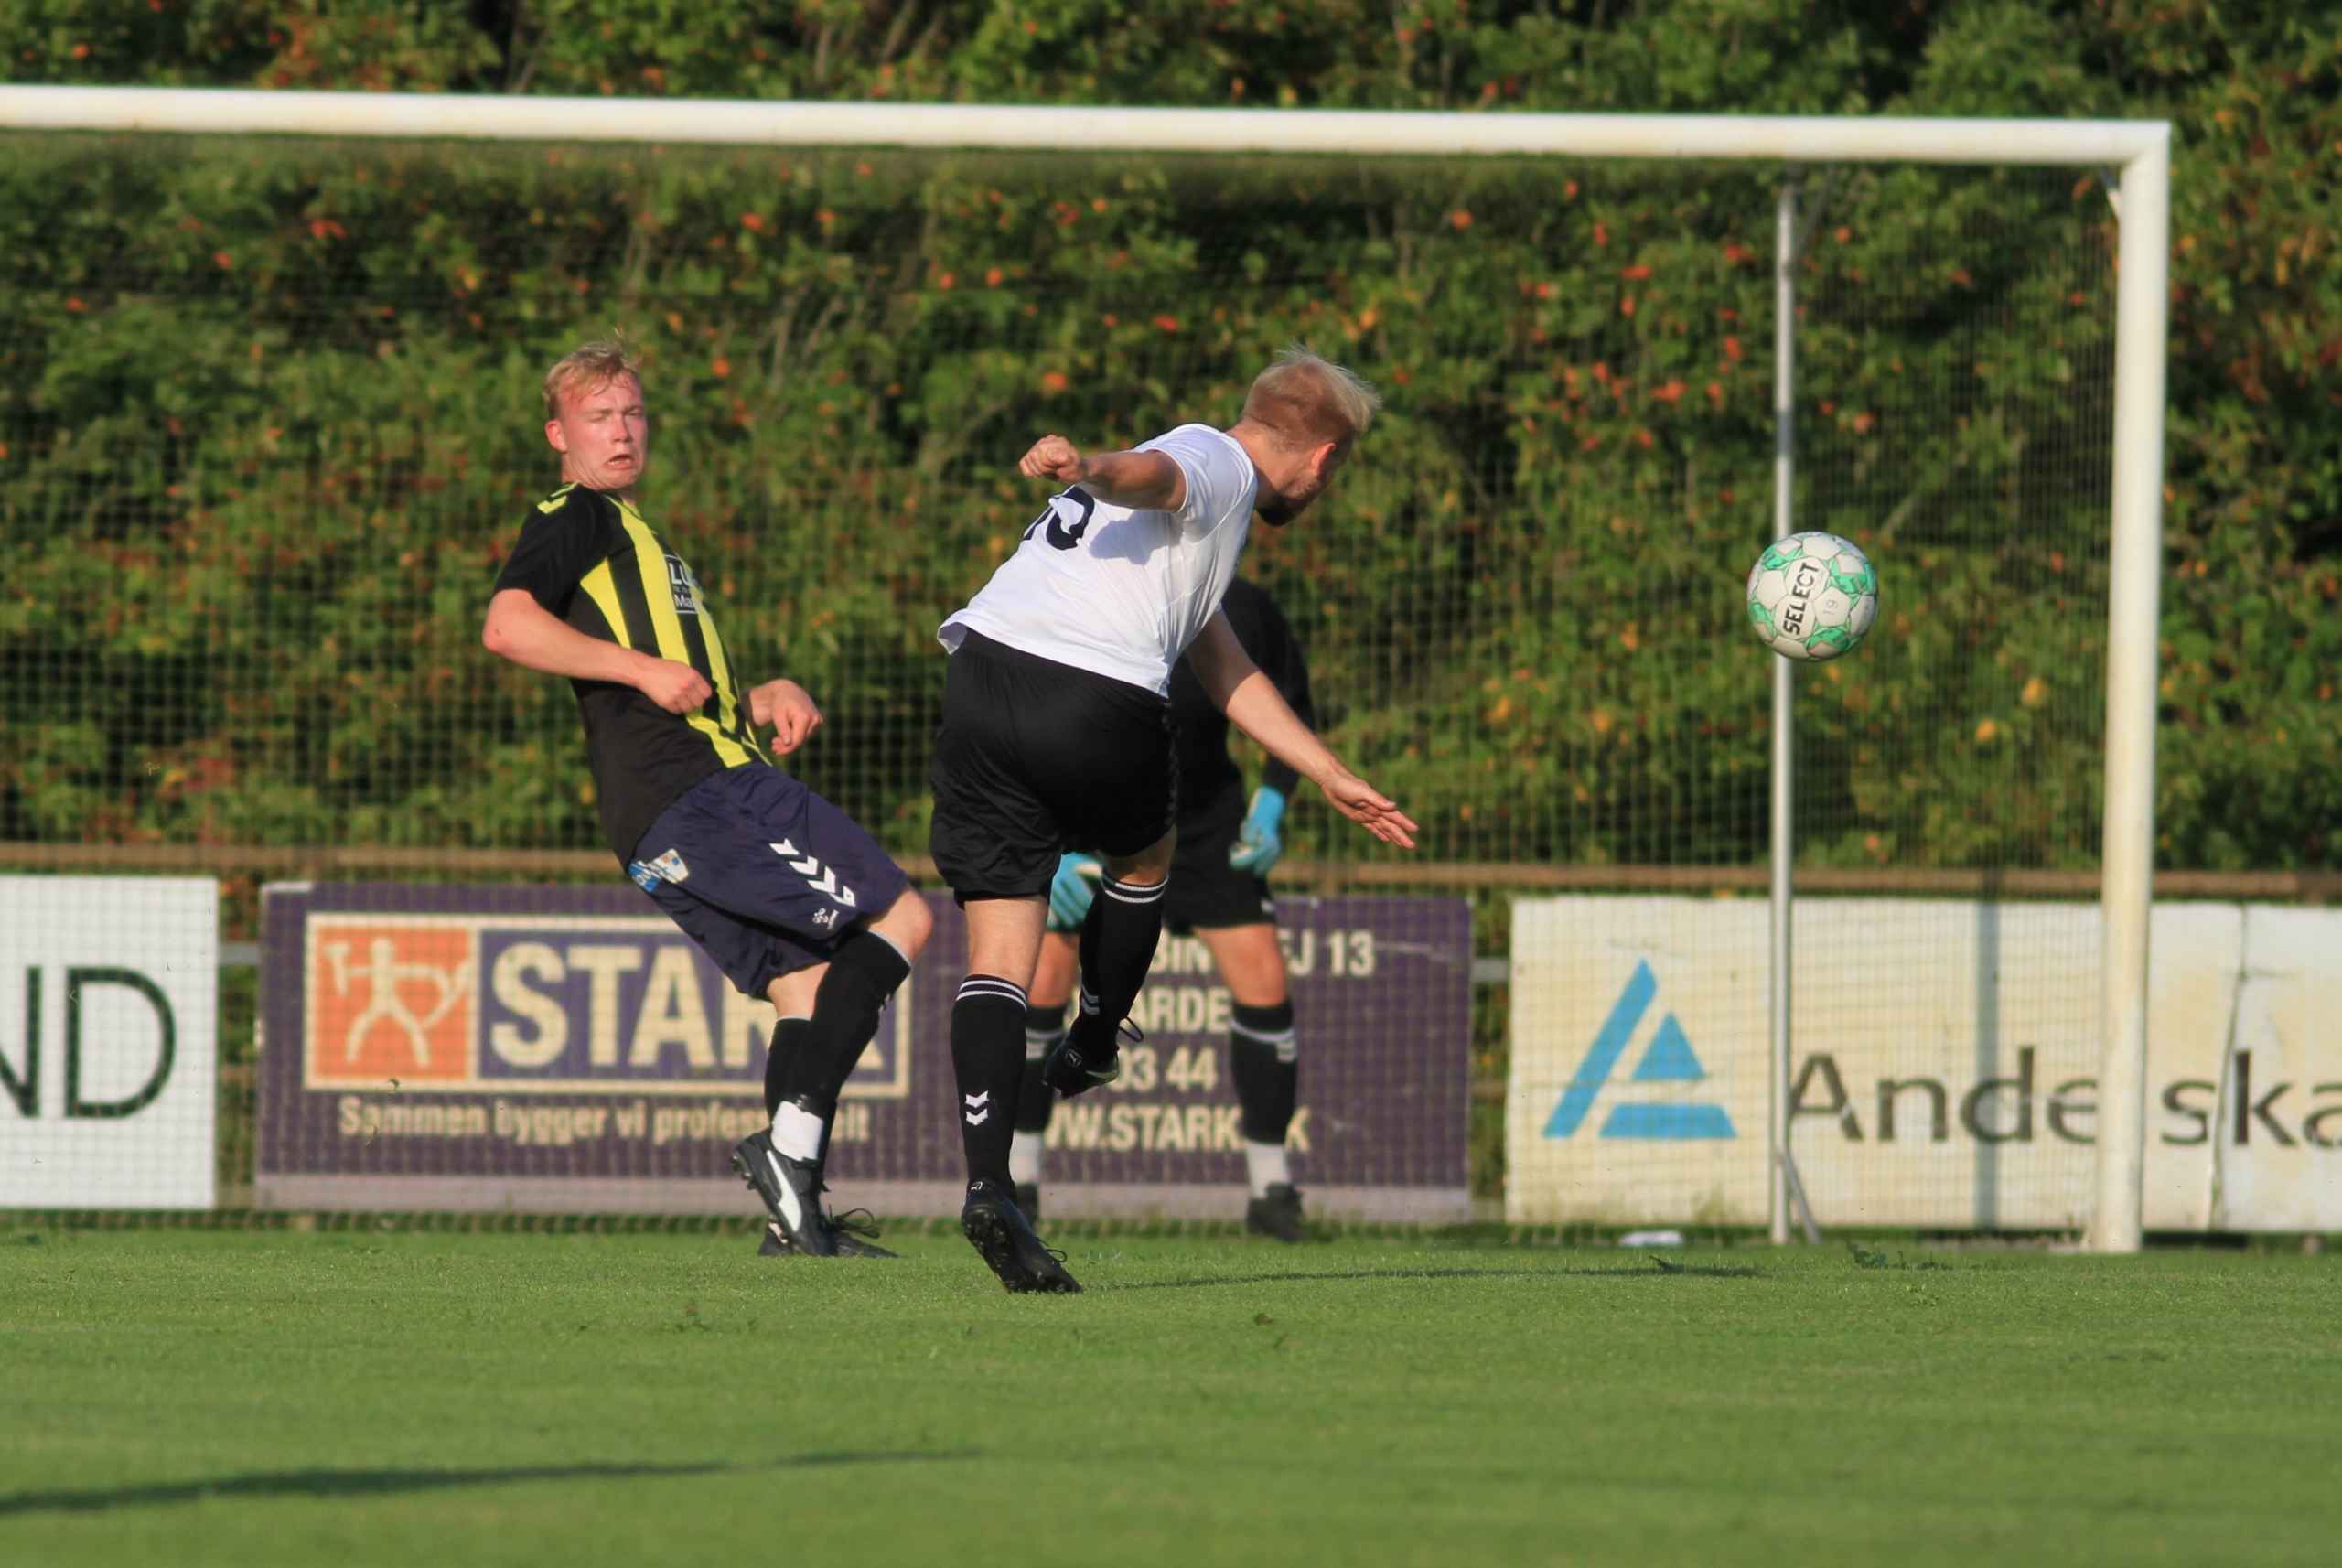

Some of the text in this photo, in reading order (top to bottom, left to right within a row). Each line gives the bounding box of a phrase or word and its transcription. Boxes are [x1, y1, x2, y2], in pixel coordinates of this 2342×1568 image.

[1783, 562, 1820, 635] SELECT
[1329, 929, 1375, 977] 13
[490, 942, 883, 1069] STAR
[1120, 985, 1230, 1034] ARDE
[1165, 1046, 1218, 1093] 44
[339, 1096, 488, 1136] Sammen
[494, 1100, 607, 1145] bygger
[614, 1100, 647, 1138] vi
[1789, 1045, 2342, 1149] Andeska
